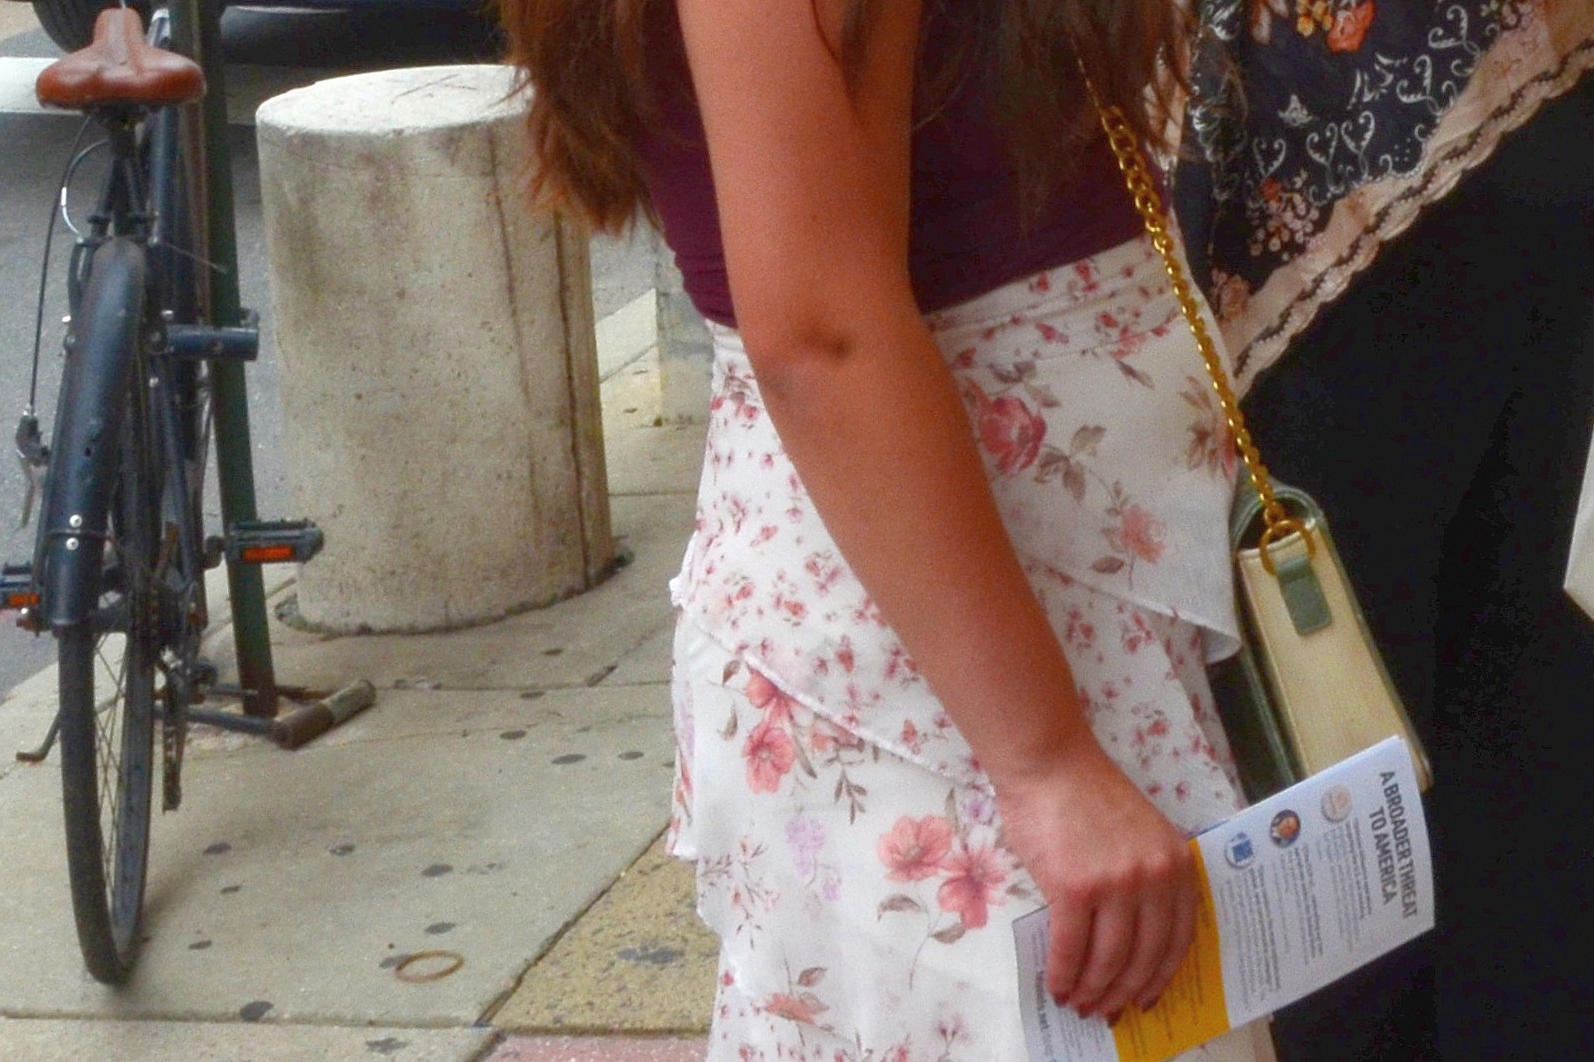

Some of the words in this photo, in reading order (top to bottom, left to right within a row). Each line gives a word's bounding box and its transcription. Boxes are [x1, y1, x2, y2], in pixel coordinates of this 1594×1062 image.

[1379, 770, 1396, 786] A
[1369, 805, 1387, 832] TO
[1384, 783, 1413, 862] BROADER
[1373, 831, 1399, 906] AMERICA
[1398, 859, 1418, 919] THREAT
